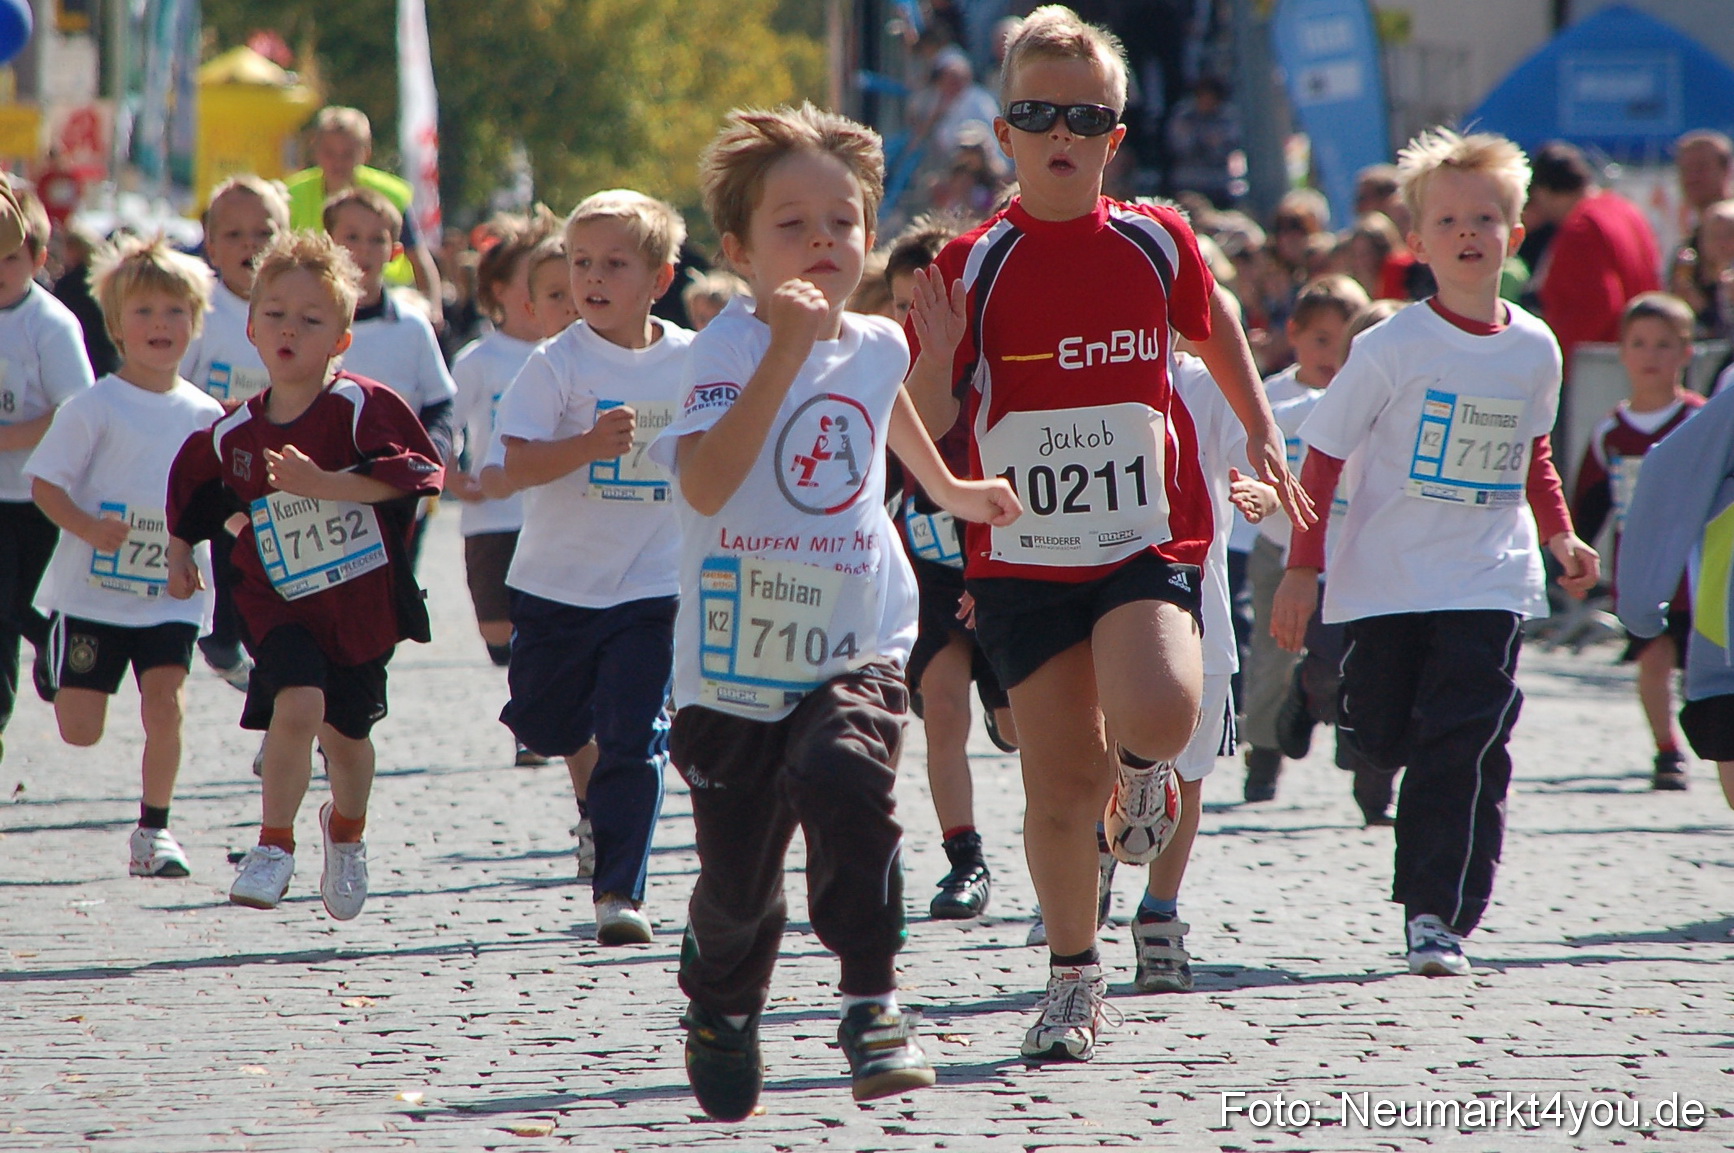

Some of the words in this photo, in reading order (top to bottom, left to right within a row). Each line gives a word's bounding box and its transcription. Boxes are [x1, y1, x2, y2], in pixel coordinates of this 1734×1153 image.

[1059, 327, 1159, 370] EnBW
[1462, 404, 1518, 428] Thomas
[1039, 420, 1114, 457] Jakob
[1423, 431, 1441, 447] K2
[1457, 438, 1524, 471] 7128
[996, 455, 1148, 516] 10211
[273, 497, 319, 521] Kenny
[261, 537, 274, 555] K2
[285, 510, 368, 560] 7152
[810, 537, 847, 553] MIT
[1034, 535, 1081, 546] PFLEIDERER
[750, 569, 822, 607] Fabian
[709, 611, 729, 632] K2
[751, 617, 860, 667] 7104
